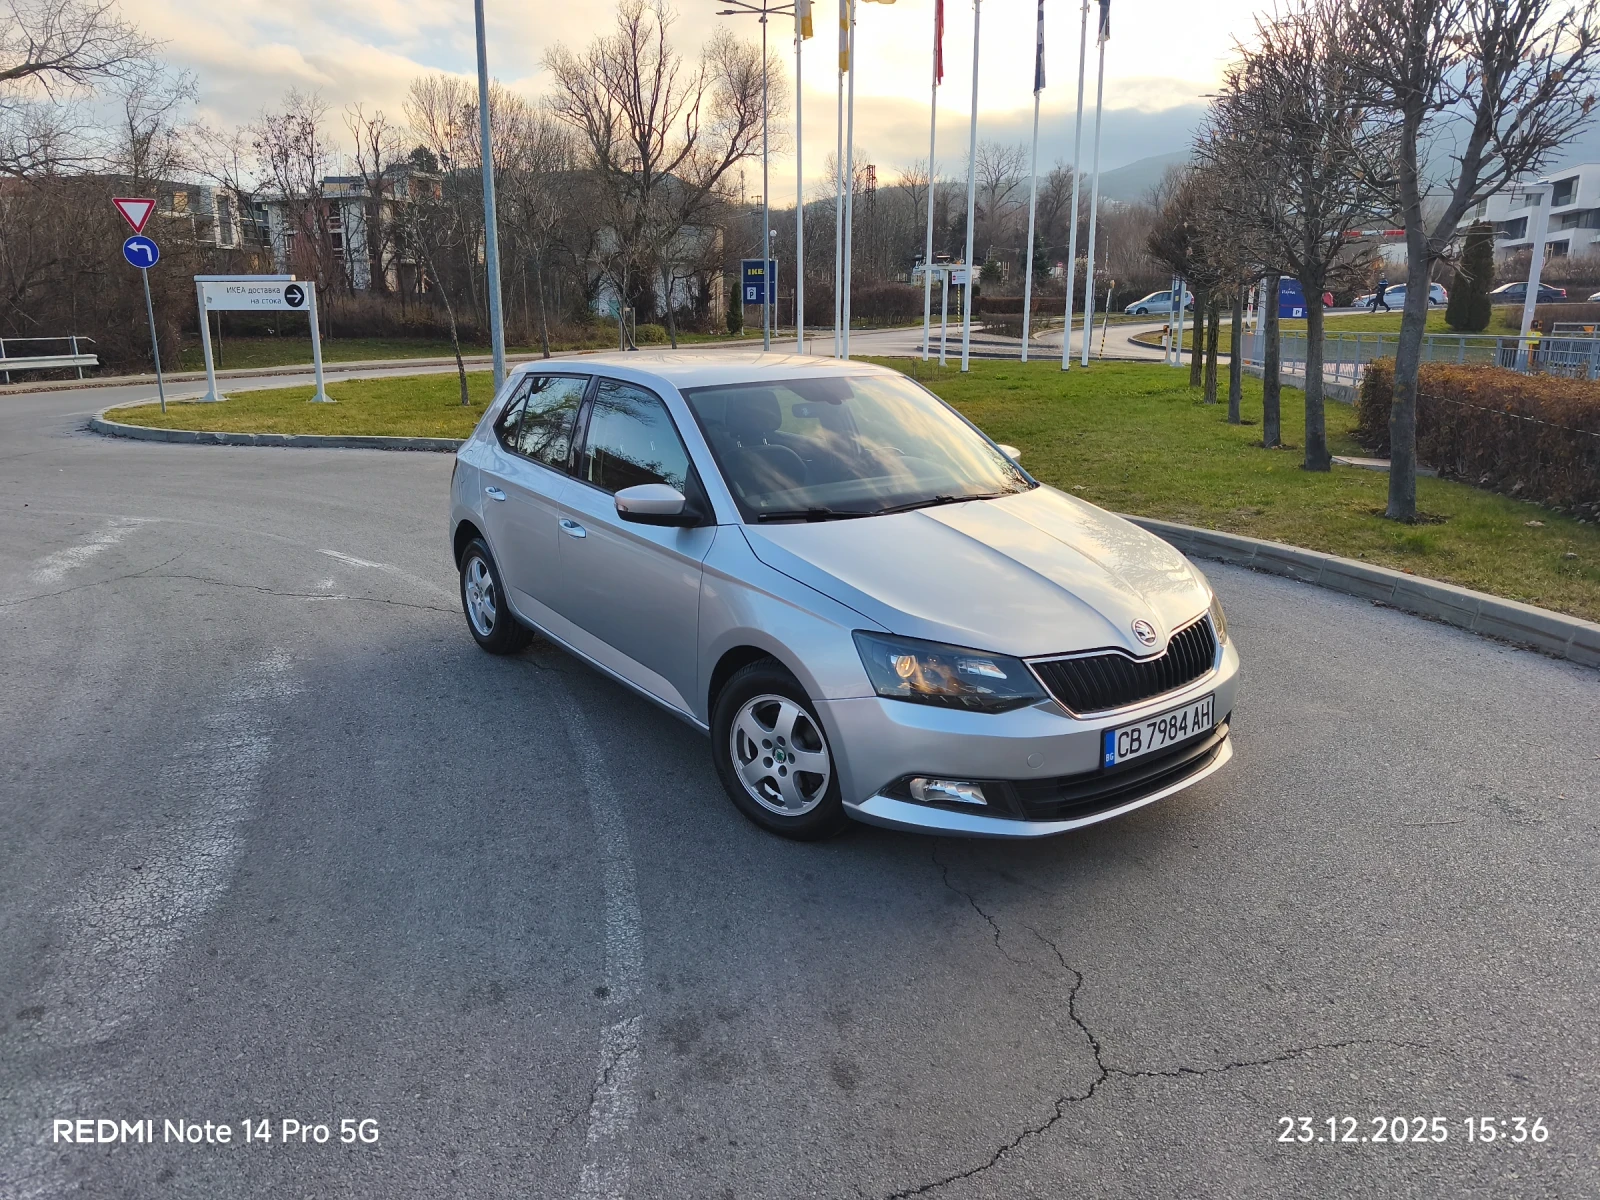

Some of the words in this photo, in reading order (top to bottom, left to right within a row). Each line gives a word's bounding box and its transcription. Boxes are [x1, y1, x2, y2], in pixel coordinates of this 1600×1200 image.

[226, 286, 246, 294] ИКЕА
[247, 287, 281, 295] доставка
[1117, 728, 1142, 758] CB
[1147, 711, 1188, 749] 7984
[1191, 701, 1210, 732] AH
[1105, 752, 1114, 763] BG
